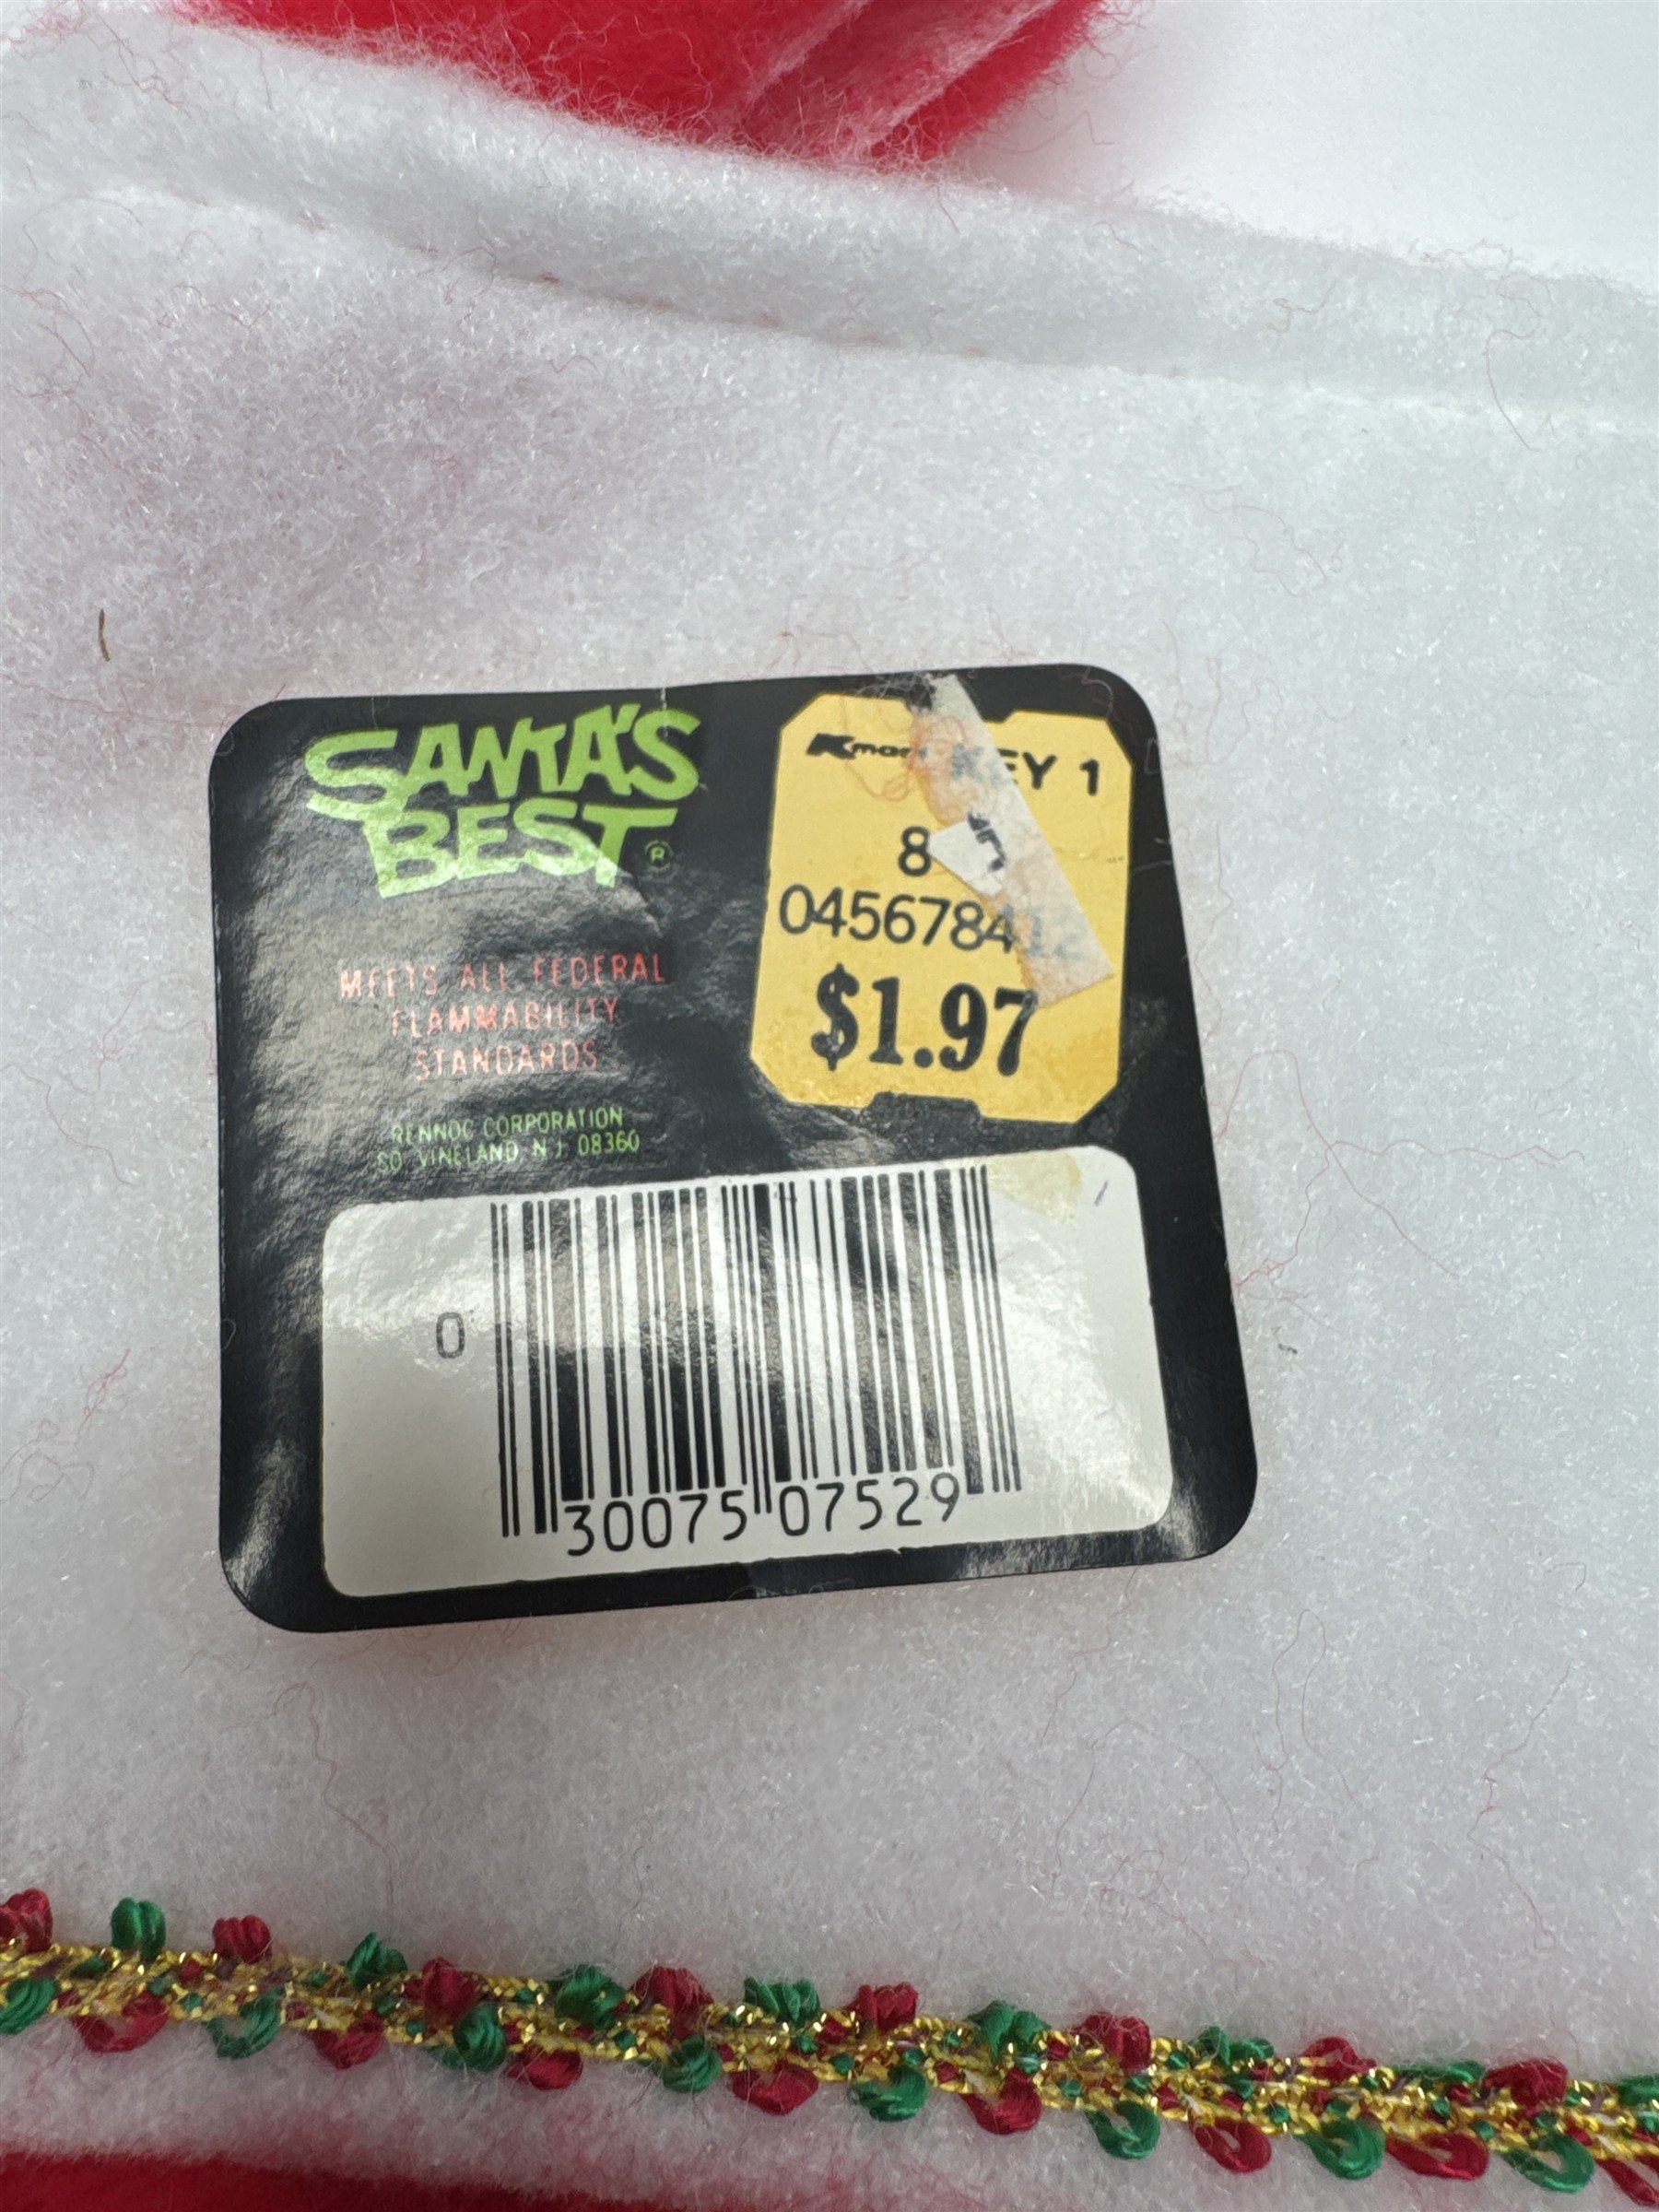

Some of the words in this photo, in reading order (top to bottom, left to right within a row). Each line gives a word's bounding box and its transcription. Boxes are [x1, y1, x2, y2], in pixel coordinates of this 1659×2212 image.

[305, 703, 701, 823] SANTA'S
[1079, 759, 1100, 796] 1
[362, 796, 678, 899] BEST
[340, 964, 440, 998] MEETS
[461, 960, 510, 992] ALL
[533, 951, 665, 989] FEDERAL
[391, 994, 618, 1038] FLAMMABILITY
[810, 962, 1040, 1077] $1.97
[415, 1038, 598, 1081] STANDARDS
[393, 1119, 474, 1145] RENNOC
[483, 1107, 623, 1138] CORPORATION
[417, 1141, 519, 1167] VINELAND
[578, 1130, 640, 1156] 08360
[436, 1312, 465, 1359] 0
[563, 1488, 748, 1556] 30075
[779, 1472, 959, 1535] 07529
